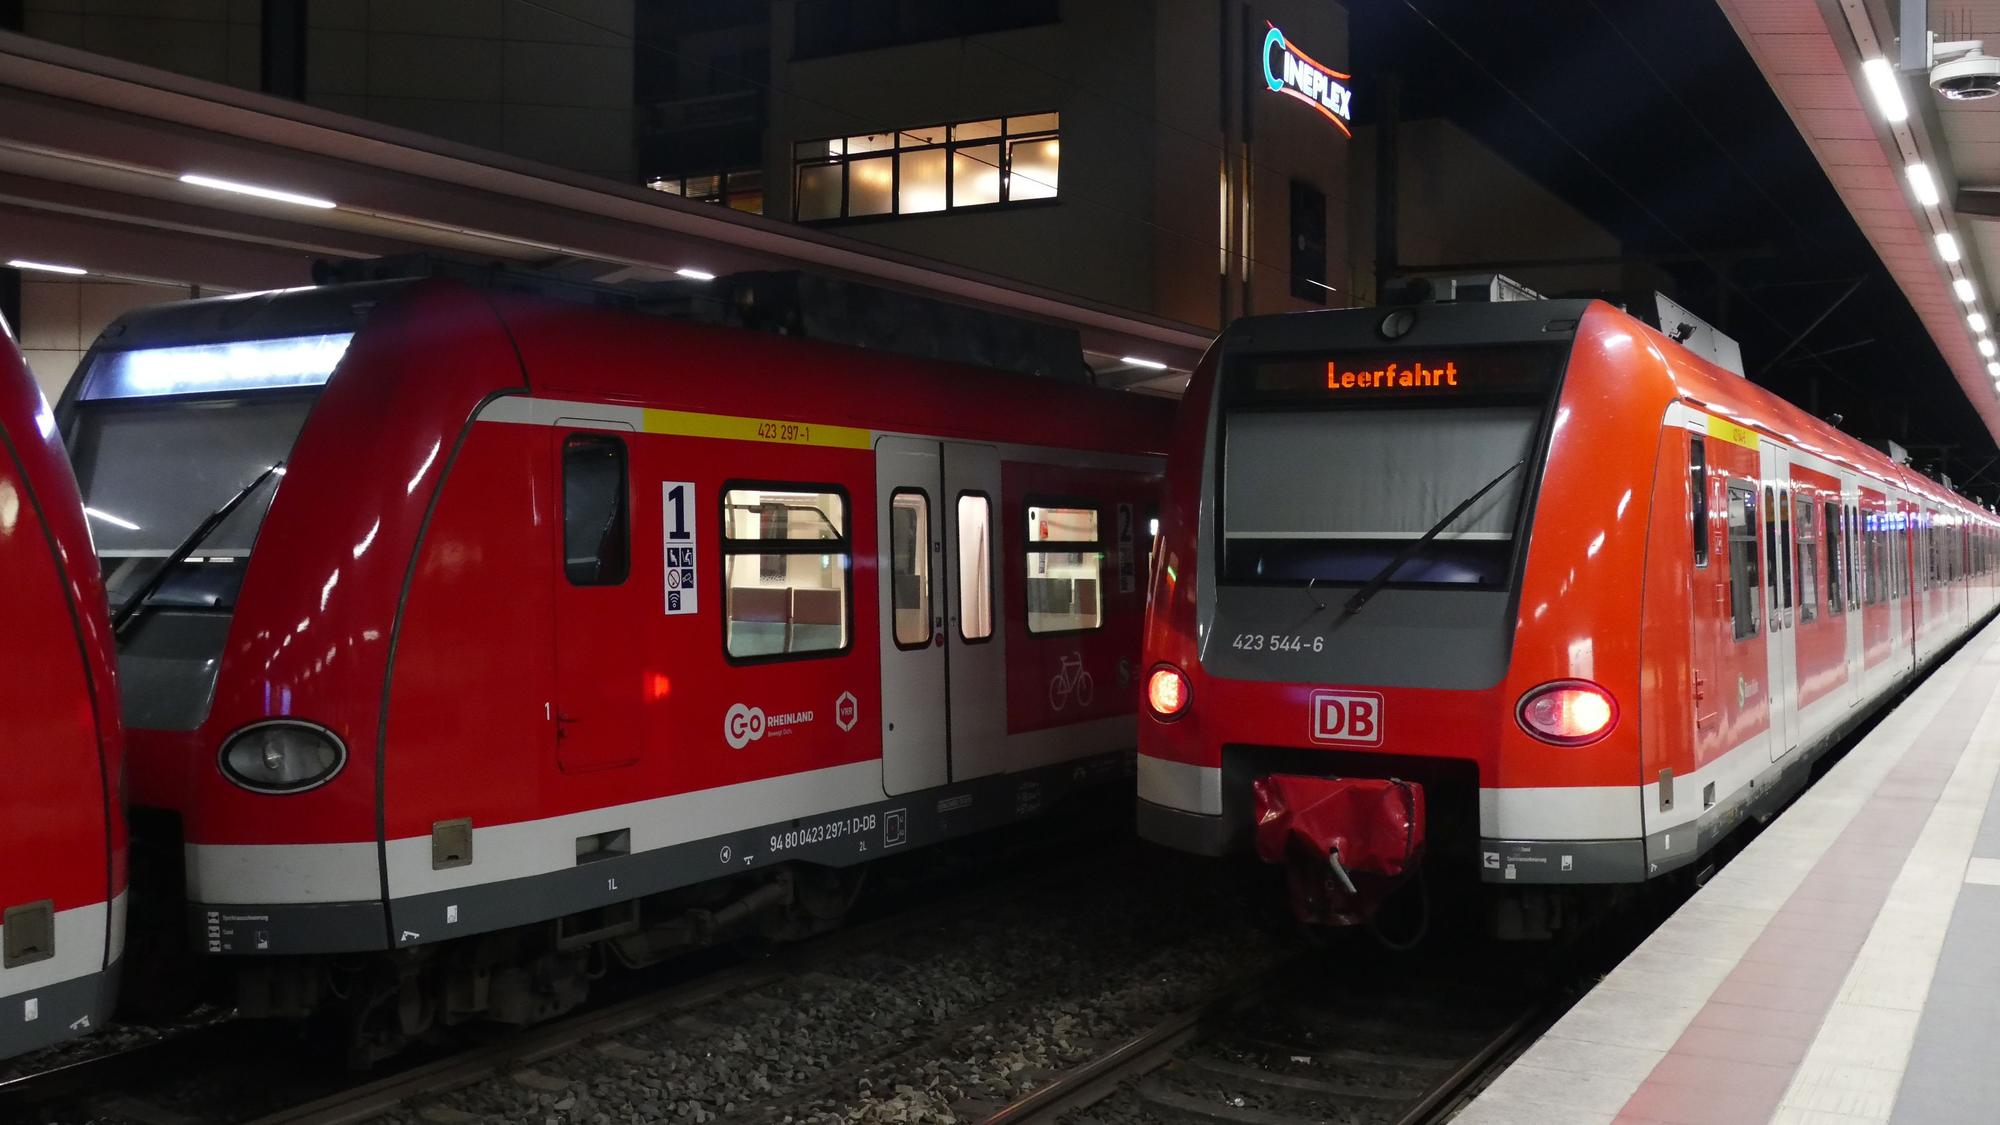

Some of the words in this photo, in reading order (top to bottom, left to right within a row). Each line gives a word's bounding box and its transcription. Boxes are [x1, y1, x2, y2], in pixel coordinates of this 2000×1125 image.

[1263, 28, 1352, 120] CINEPLEX
[1328, 362, 1457, 388] Leerfahrt
[758, 423, 777, 439] 423
[781, 424, 809, 441] 297-1
[668, 486, 691, 540] 1
[1233, 634, 1265, 650] 423
[1270, 635, 1324, 652] 544-6
[545, 702, 550, 721] 1
[767, 710, 814, 727] RHEINLAND
[1319, 699, 1374, 737] DB
[770, 835, 783, 852] 94
[785, 831, 798, 849] 80
[799, 827, 824, 845] 0423
[826, 819, 850, 840] 297-1
[853, 814, 876, 833] D-DB
[608, 878, 618, 891] 1L
